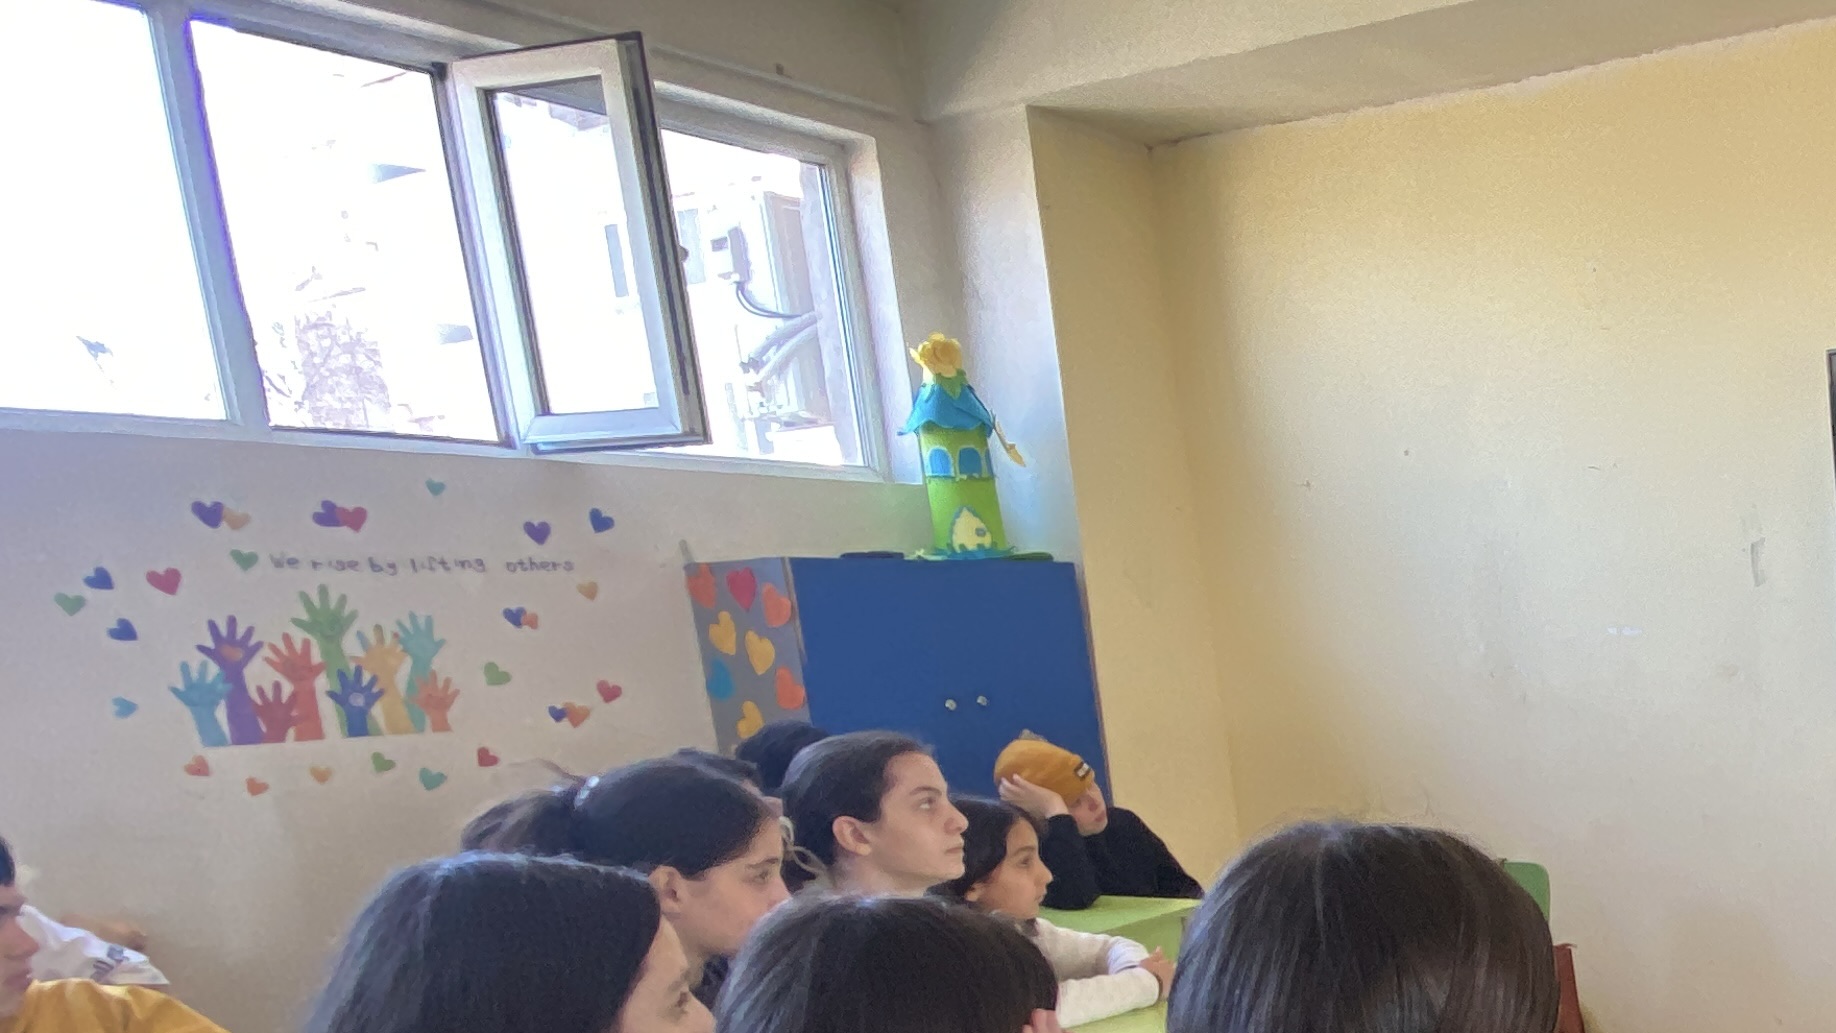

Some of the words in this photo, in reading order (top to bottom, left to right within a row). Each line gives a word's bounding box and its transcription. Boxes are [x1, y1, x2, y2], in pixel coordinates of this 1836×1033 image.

[269, 553, 300, 569] We
[367, 556, 398, 576] by
[409, 557, 487, 574] lifting
[505, 557, 575, 573] others
